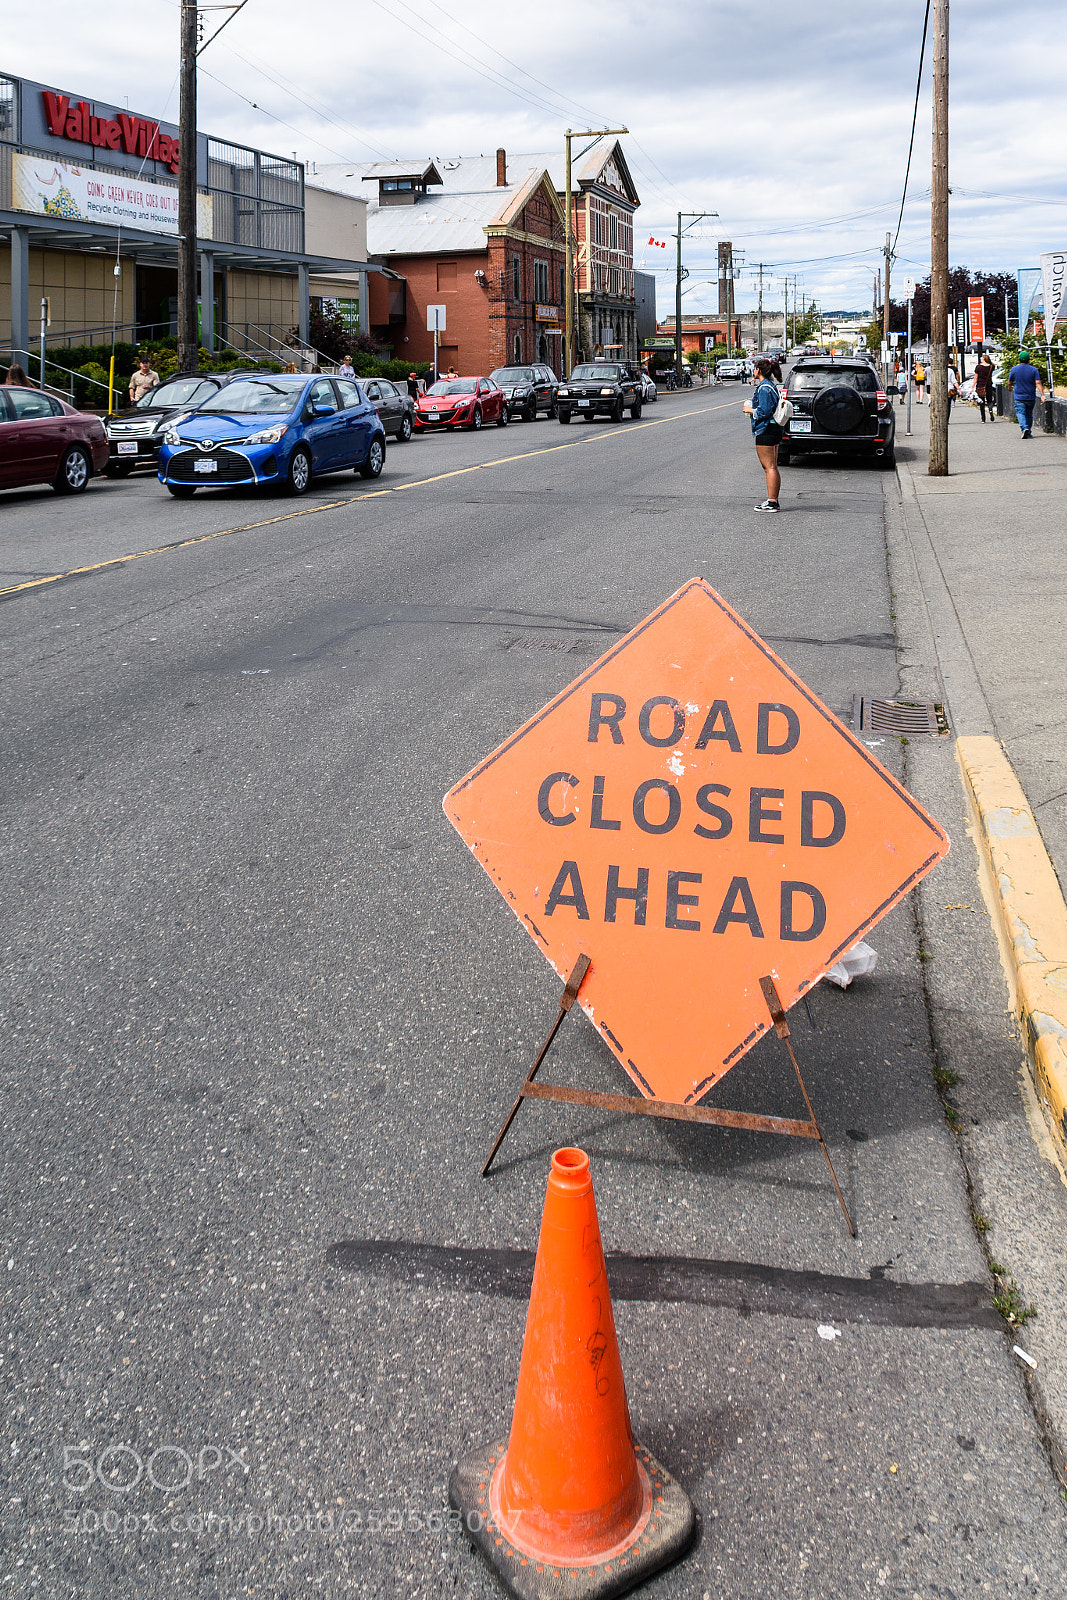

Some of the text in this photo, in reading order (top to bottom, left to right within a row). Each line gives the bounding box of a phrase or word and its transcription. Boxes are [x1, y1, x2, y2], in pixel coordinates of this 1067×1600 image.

[117, 113, 179, 174] Villag
[87, 182, 104, 197] GOING
[107, 186, 124, 203] GREEN
[126, 189, 144, 207] NEVER
[145, 193, 159, 207] GOES
[160, 196, 170, 209] OUT
[87, 202, 179, 224] Recycle Clothing and Houseware
[587, 692, 800, 755] ROAD
[537, 771, 846, 847] CLOSED
[544, 860, 827, 942] AHEAD
